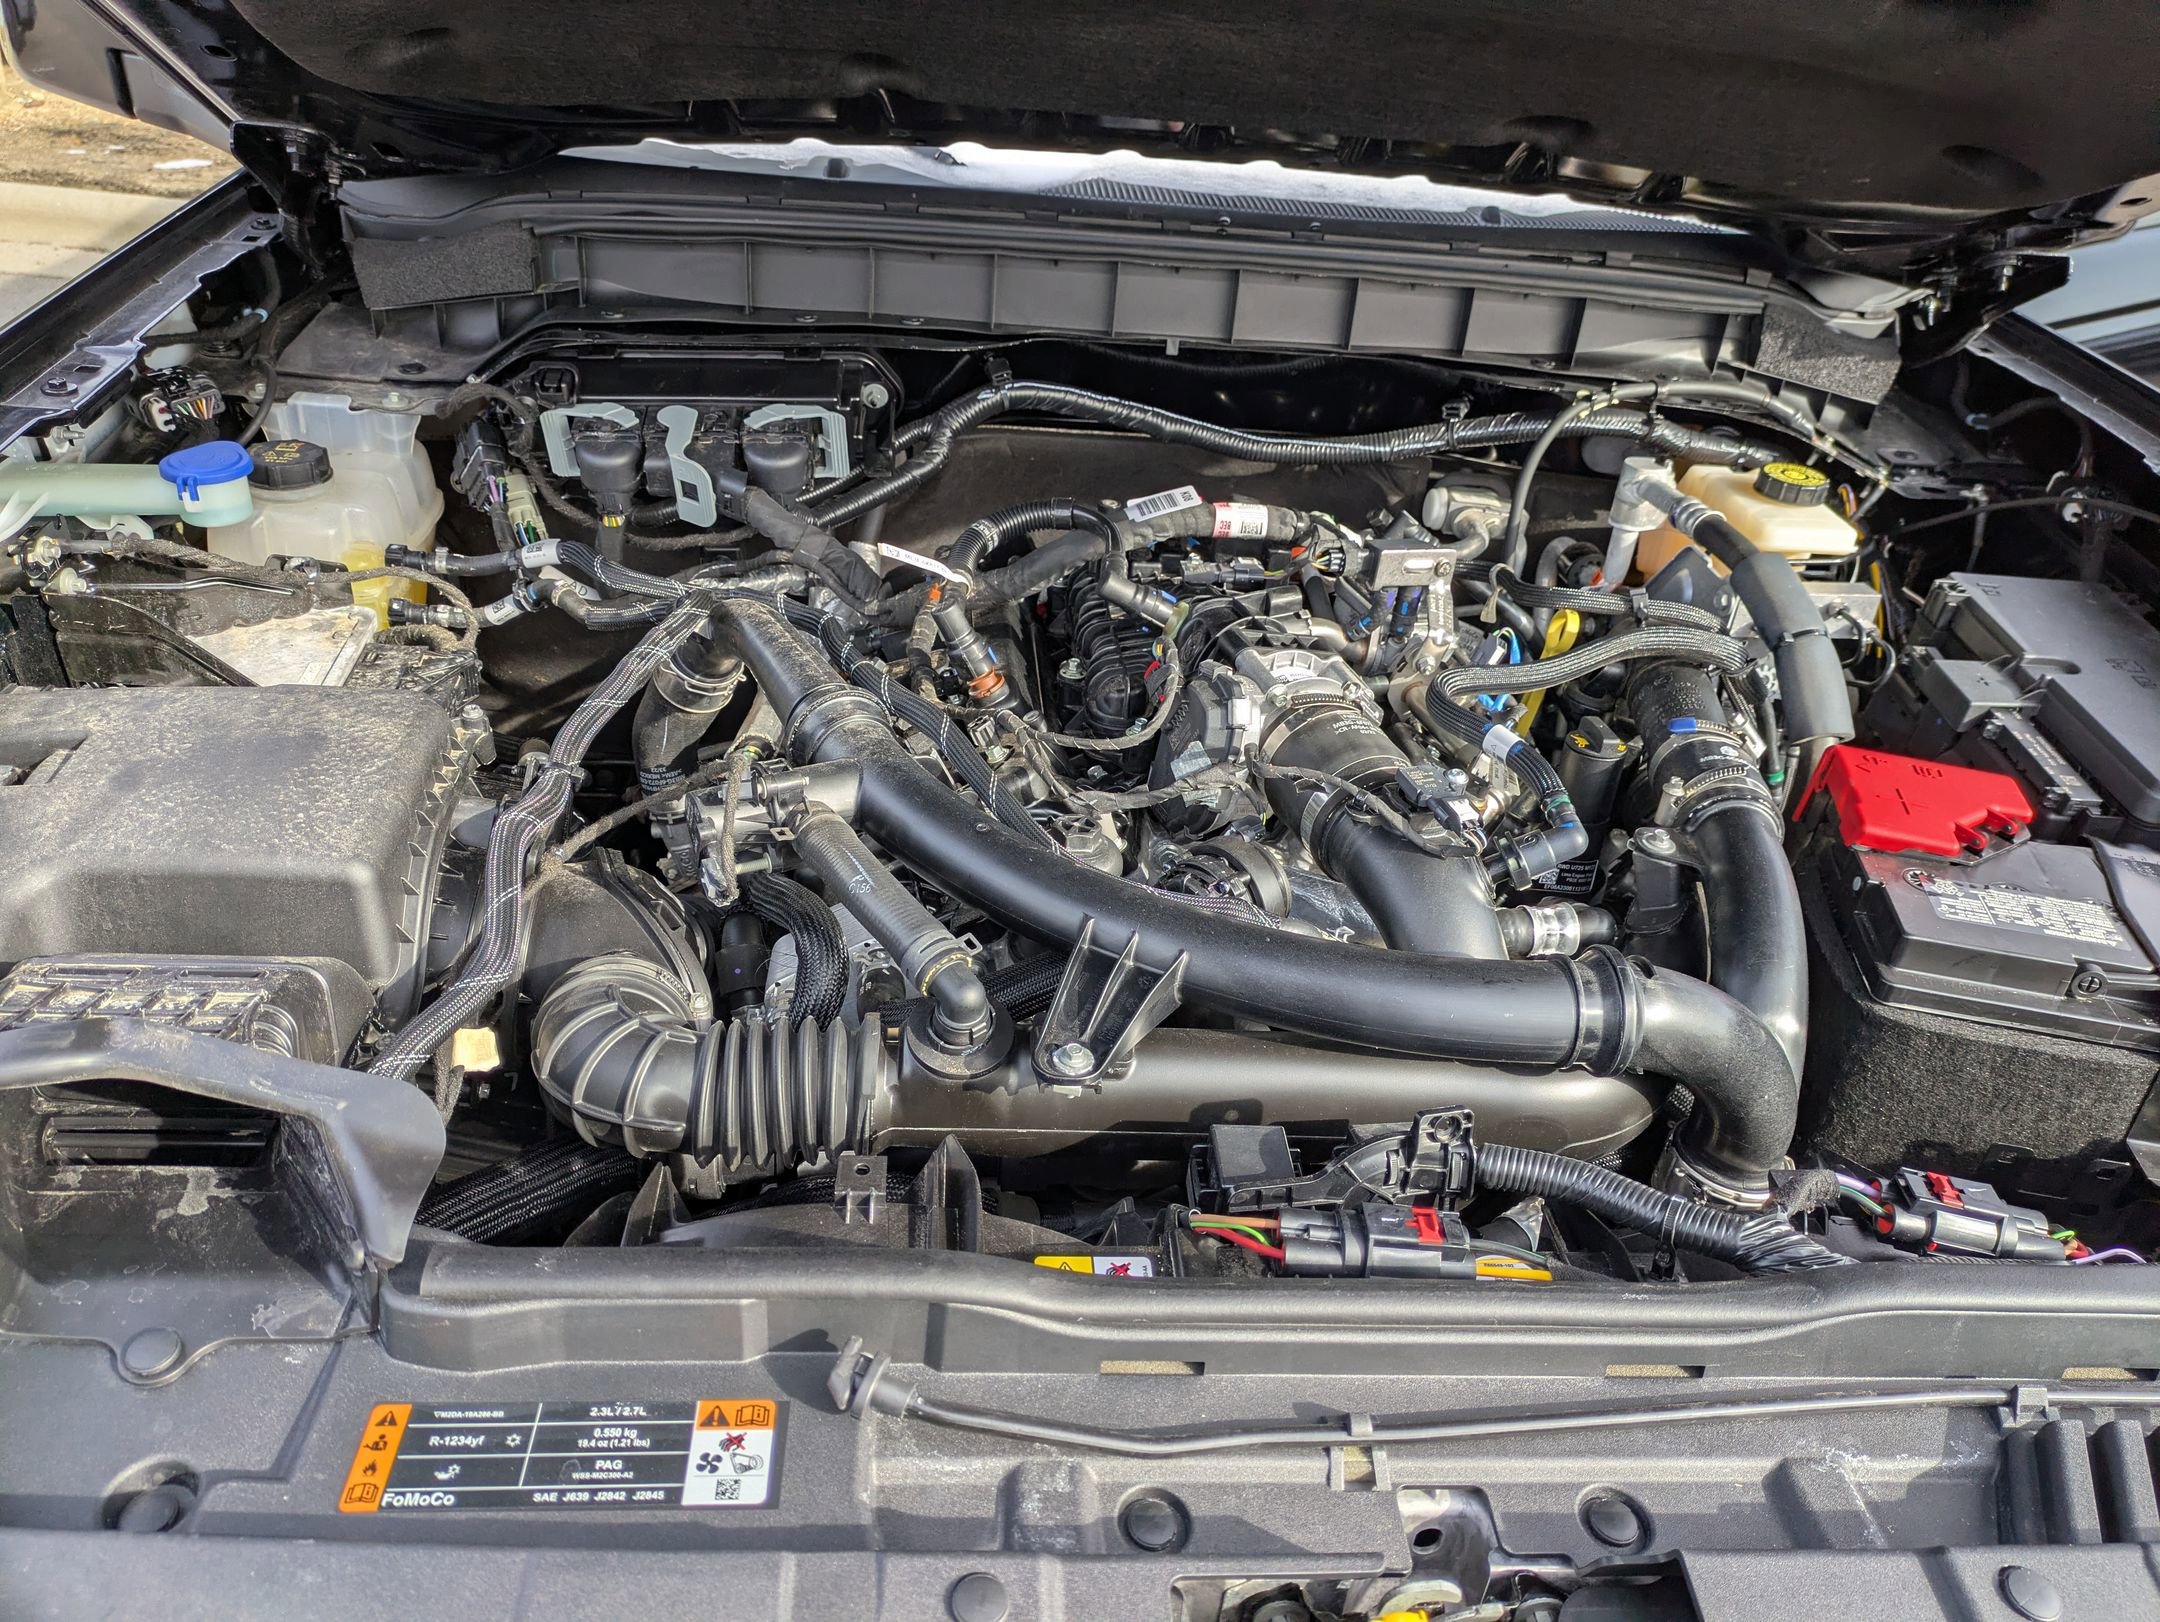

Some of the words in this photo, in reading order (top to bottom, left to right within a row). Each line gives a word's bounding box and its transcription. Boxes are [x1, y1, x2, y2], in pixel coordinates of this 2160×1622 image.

[589, 1406, 614, 1417] 2.3L
[622, 1406, 647, 1416] 2.7L
[593, 1428, 622, 1438] 0.550
[623, 1428, 637, 1439] kg
[428, 1435, 486, 1449] R-1234yf
[577, 1439, 596, 1448] 19.4
[597, 1440, 609, 1448] oz
[609, 1439, 632, 1449] (1.21
[633, 1438, 650, 1448] lbs)
[594, 1459, 623, 1470] PAG
[381, 1492, 455, 1507] FoMoCo
[532, 1491, 558, 1502] SAE
[562, 1491, 589, 1502] J639
[593, 1490, 627, 1501] J2842
[632, 1490, 665, 1501] J2845
